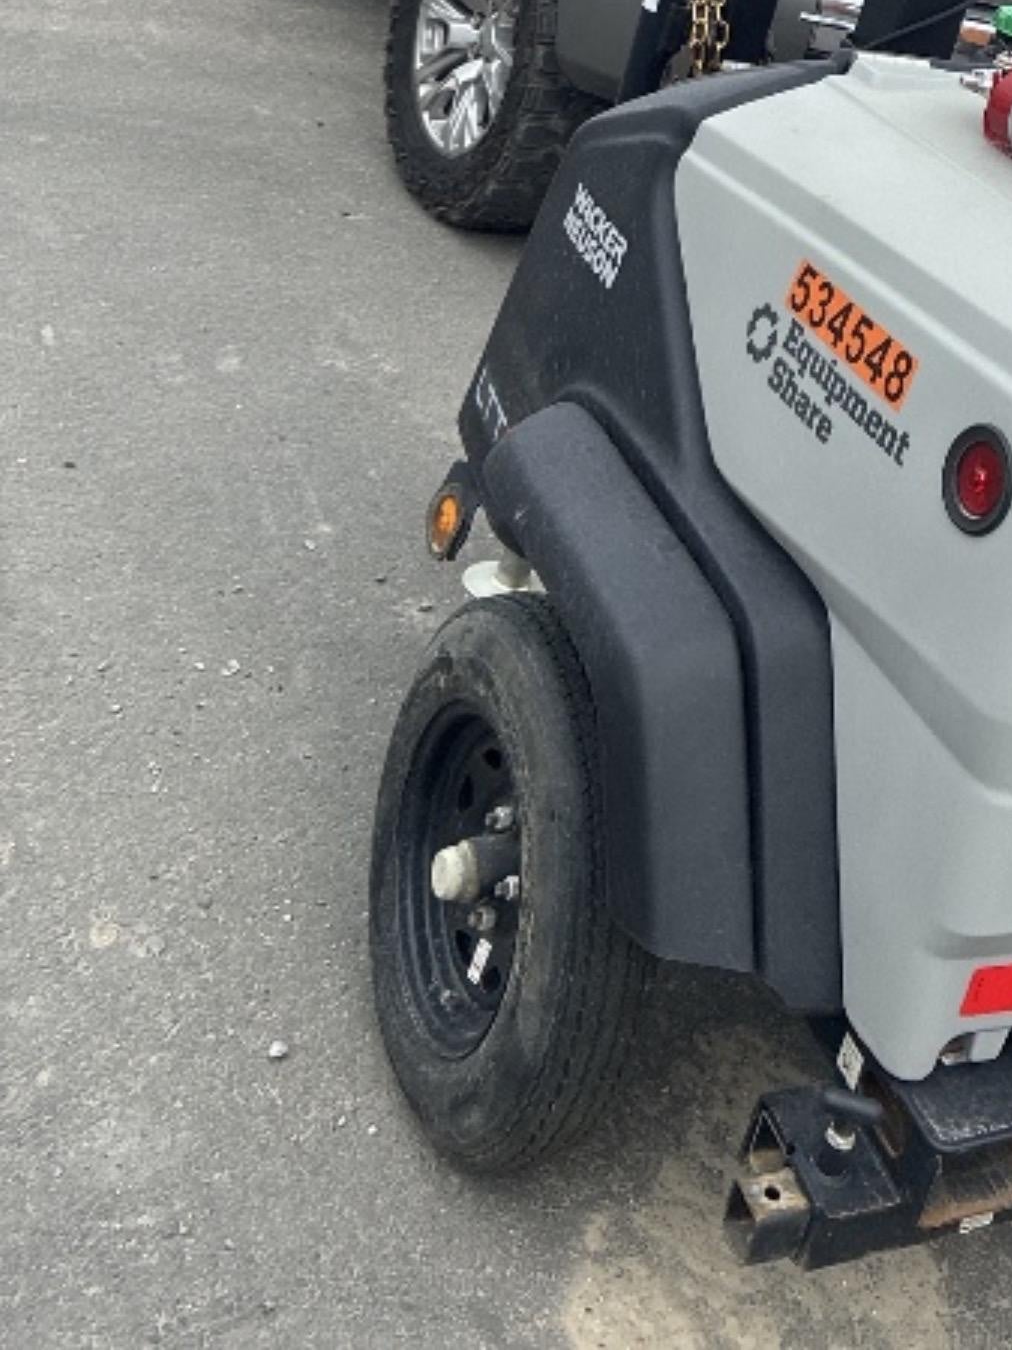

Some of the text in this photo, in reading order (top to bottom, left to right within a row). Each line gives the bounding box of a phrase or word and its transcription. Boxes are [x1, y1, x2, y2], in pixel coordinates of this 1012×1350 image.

[574, 182, 628, 267] WACKER
[790, 263, 913, 403] 534548
[767, 356, 832, 445] Share
[782, 318, 910, 466] Equipment
